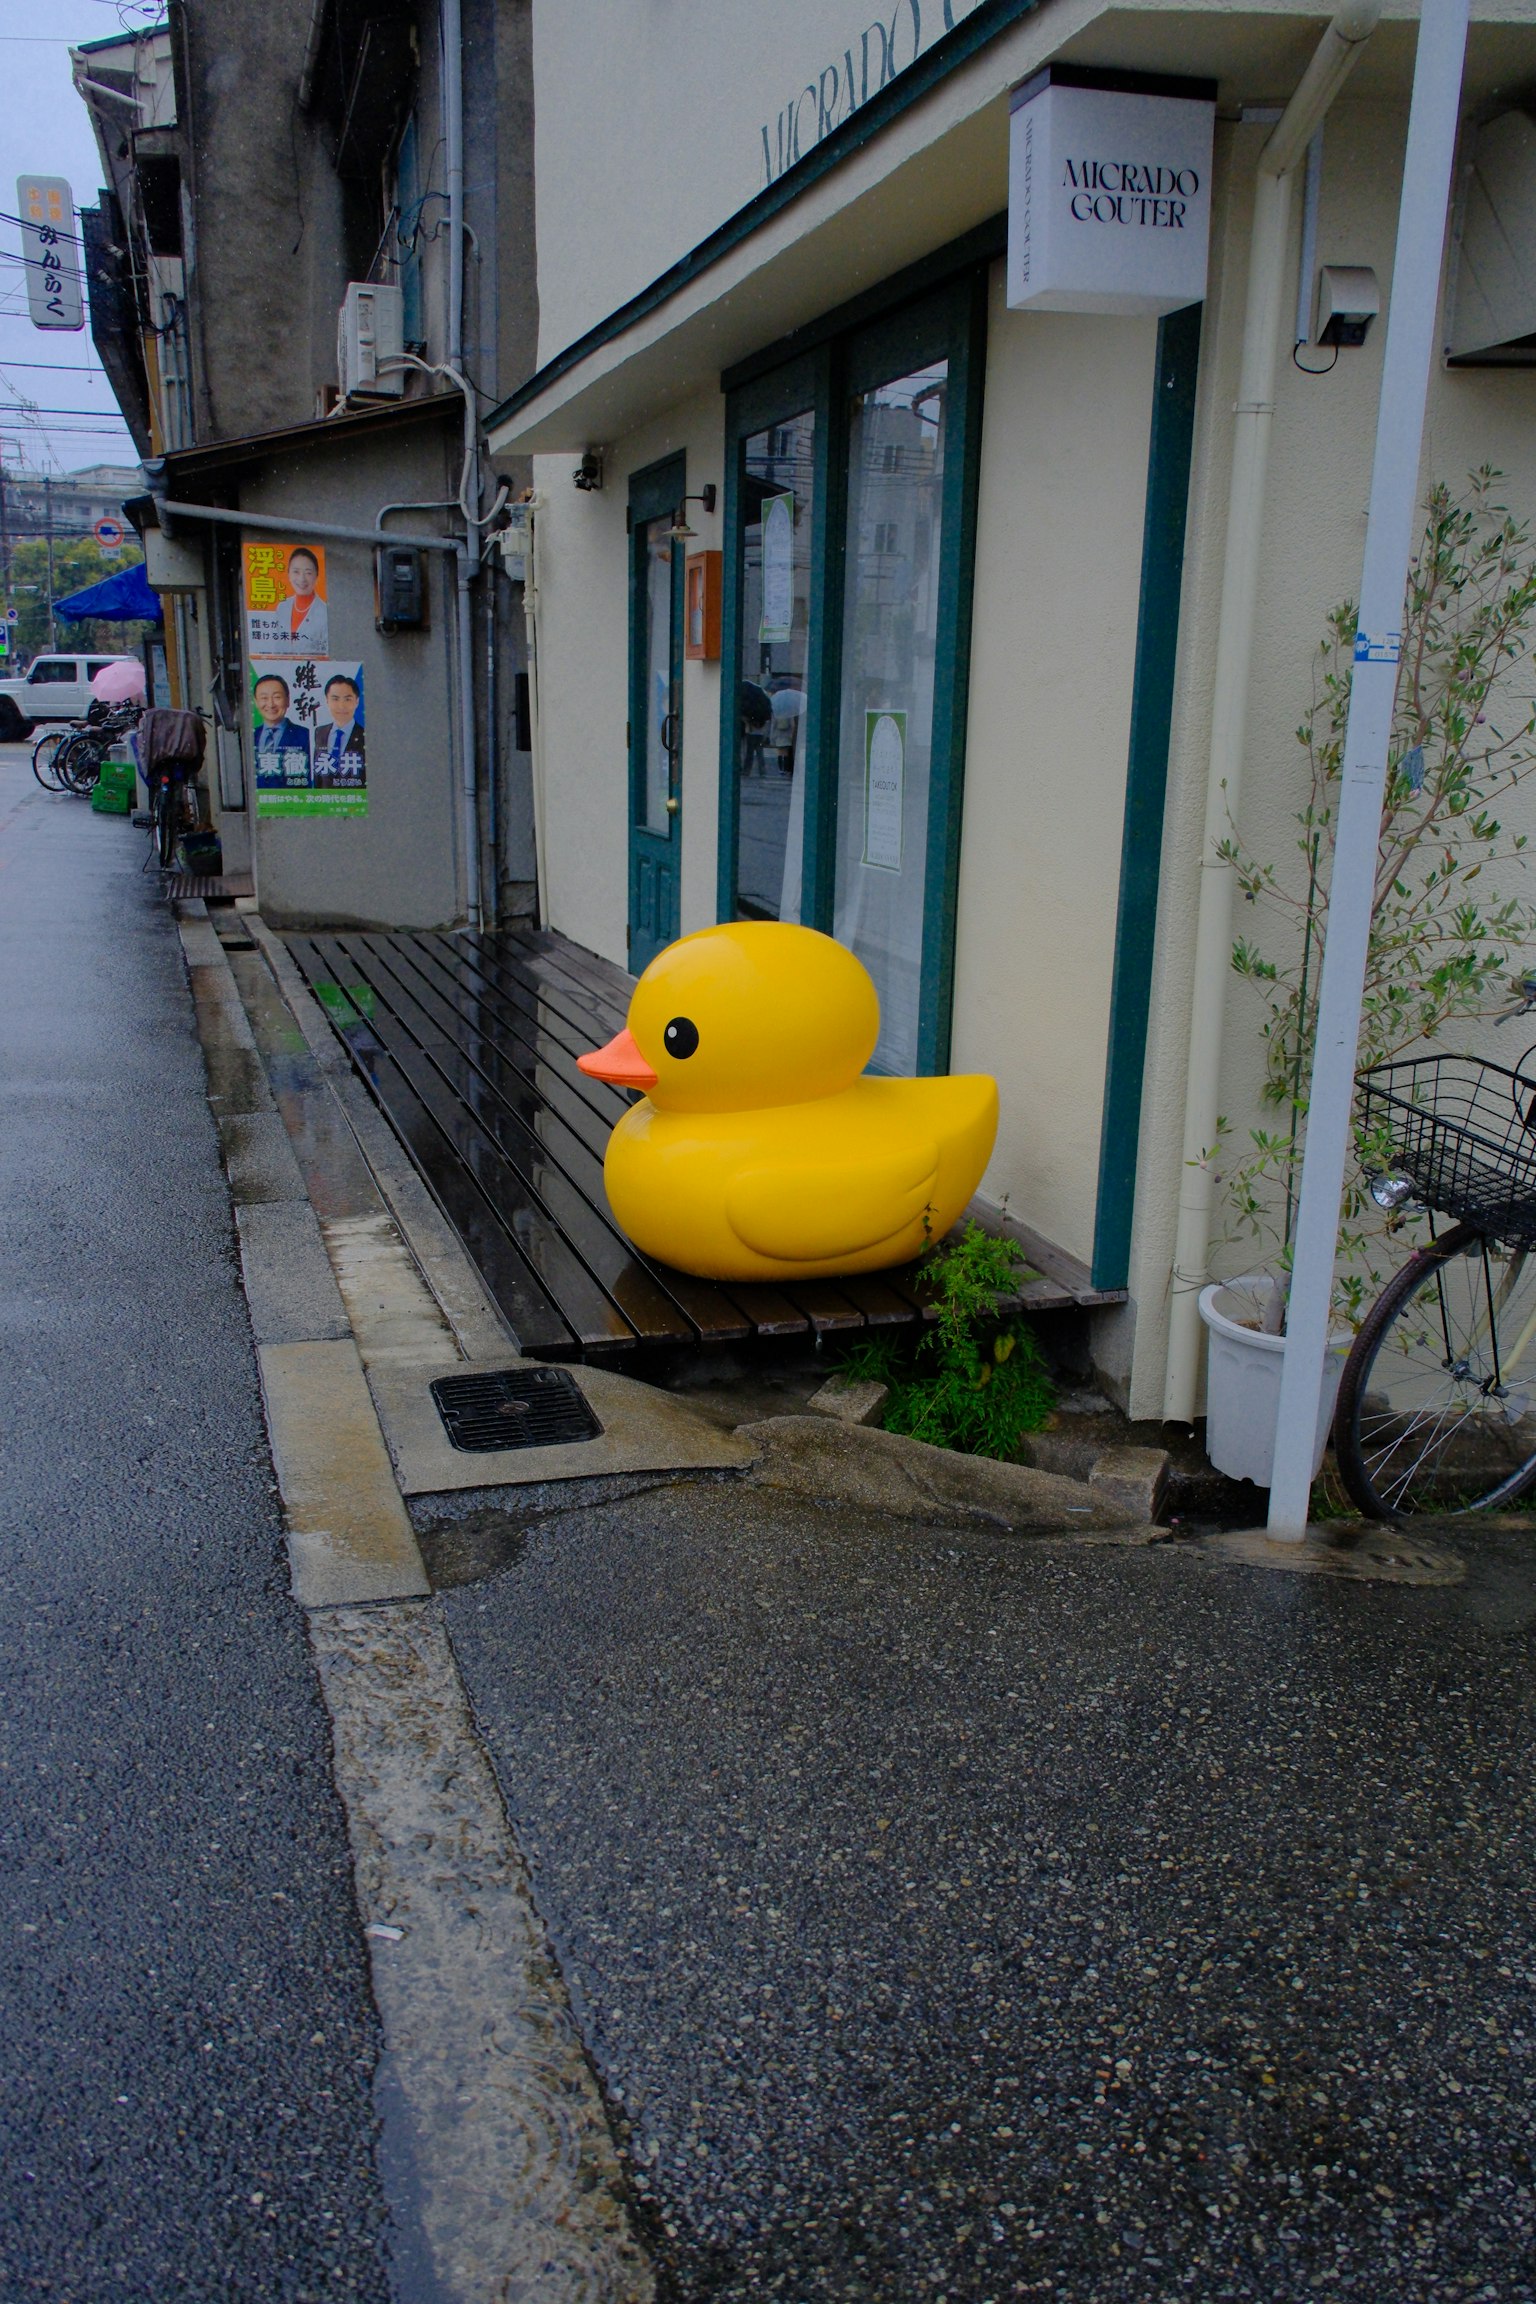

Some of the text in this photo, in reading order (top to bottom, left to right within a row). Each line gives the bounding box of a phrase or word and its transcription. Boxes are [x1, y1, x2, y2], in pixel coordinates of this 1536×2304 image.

[1062, 159, 1199, 197] MICRADO
[1070, 192, 1186, 228] GOUTER
[248, 547, 276, 603] 浮島
[276, 550, 287, 601] うきしま
[251, 618, 284, 628] 誰もが、
[293, 661, 322, 727] 維新
[315, 752, 363, 776] 永井
